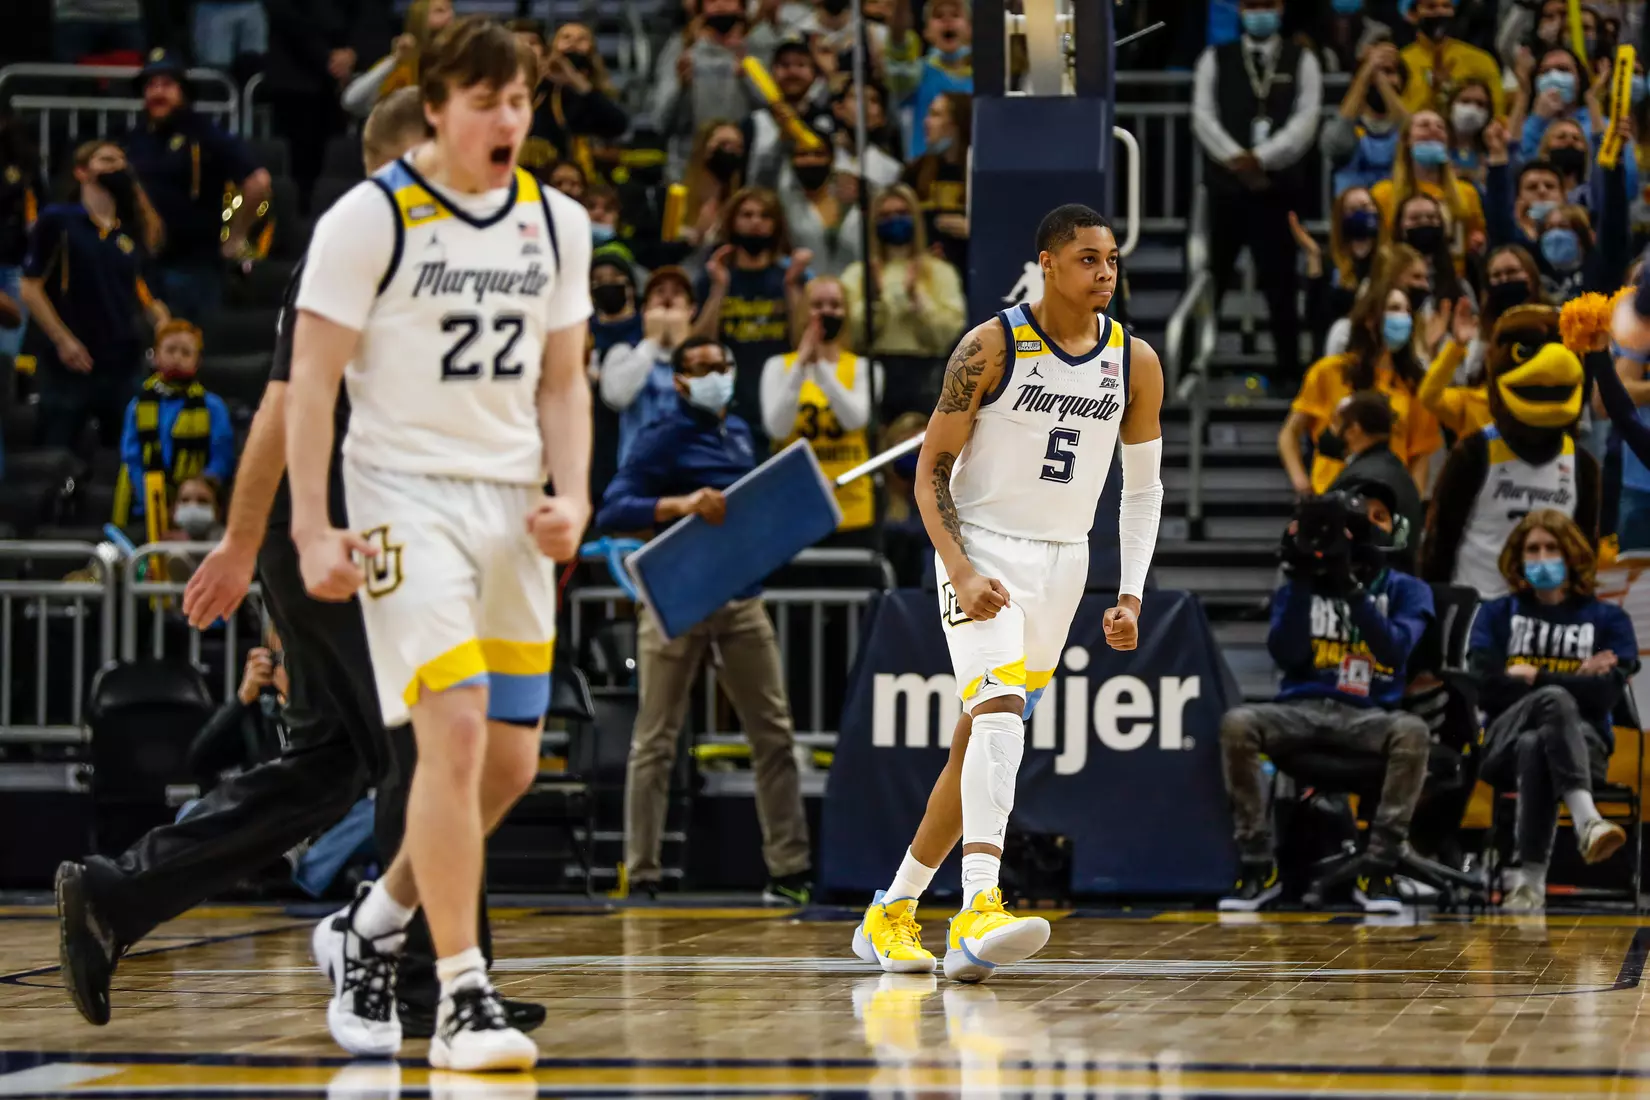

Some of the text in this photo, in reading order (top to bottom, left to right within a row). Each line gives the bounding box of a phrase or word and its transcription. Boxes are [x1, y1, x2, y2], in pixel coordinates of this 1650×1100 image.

[412, 261, 548, 303] Marquette
[440, 310, 527, 382] 22
[1012, 384, 1120, 422] Marquette
[1039, 427, 1081, 484] 5
[872, 646, 1200, 775] mijer
